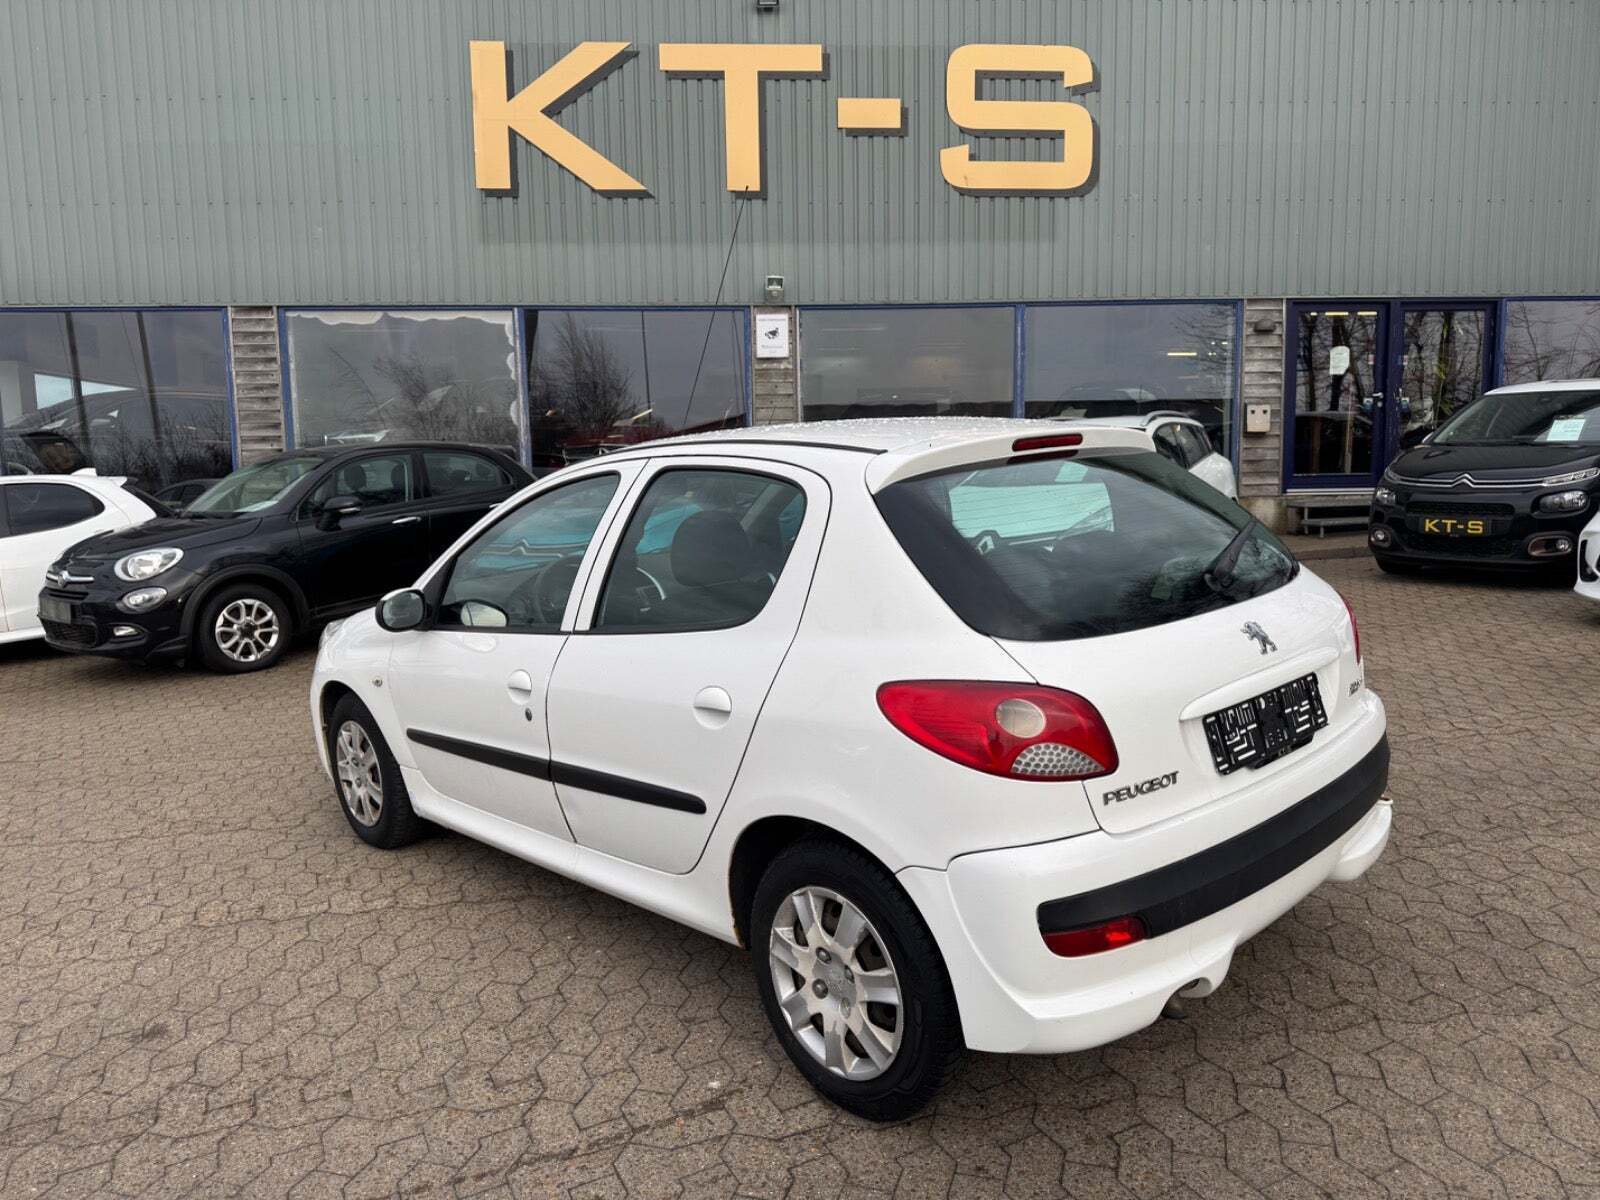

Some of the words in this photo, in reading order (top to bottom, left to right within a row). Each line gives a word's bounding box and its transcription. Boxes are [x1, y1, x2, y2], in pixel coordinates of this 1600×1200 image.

[469, 40, 1095, 192] KT-S
[1424, 518, 1483, 534] KT-S
[1103, 770, 1179, 806] PEUGEOT
